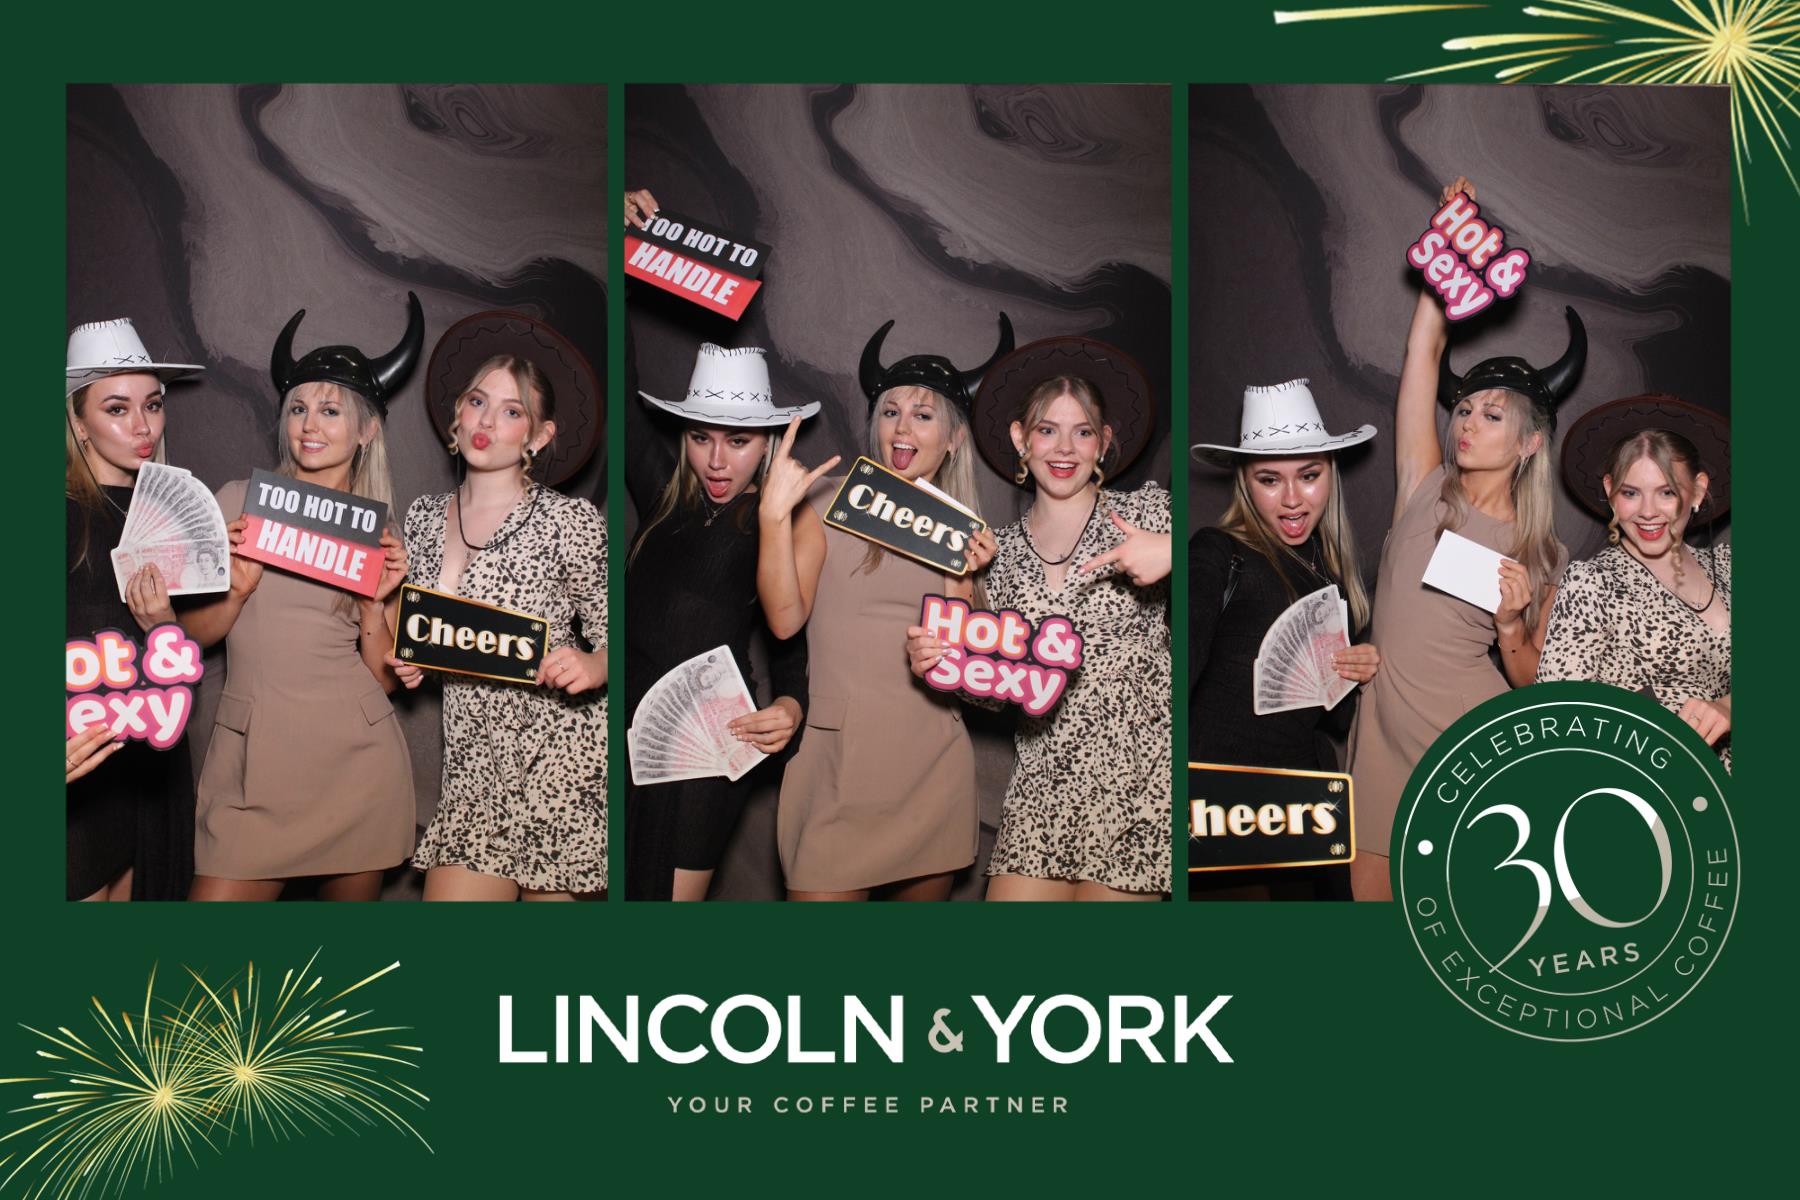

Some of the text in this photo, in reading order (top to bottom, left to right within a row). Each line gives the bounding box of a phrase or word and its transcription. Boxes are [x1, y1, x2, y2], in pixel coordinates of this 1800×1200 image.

[628, 242, 740, 306] HANDLE
[682, 228, 730, 257] HOT
[728, 242, 759, 267] TO
[1411, 232, 1489, 315] Sexy
[1435, 197, 1524, 293] Hot &
[258, 482, 377, 533] TOO HOT TO
[847, 483, 969, 552] Cheers
[256, 518, 368, 582] HANDLE
[66, 632, 197, 686] ot &
[406, 613, 535, 661] Cheers
[927, 602, 1077, 664] Hot &
[930, 649, 1060, 710] Sexy
[69, 692, 185, 742] exy
[1190, 799, 1338, 836] heers
